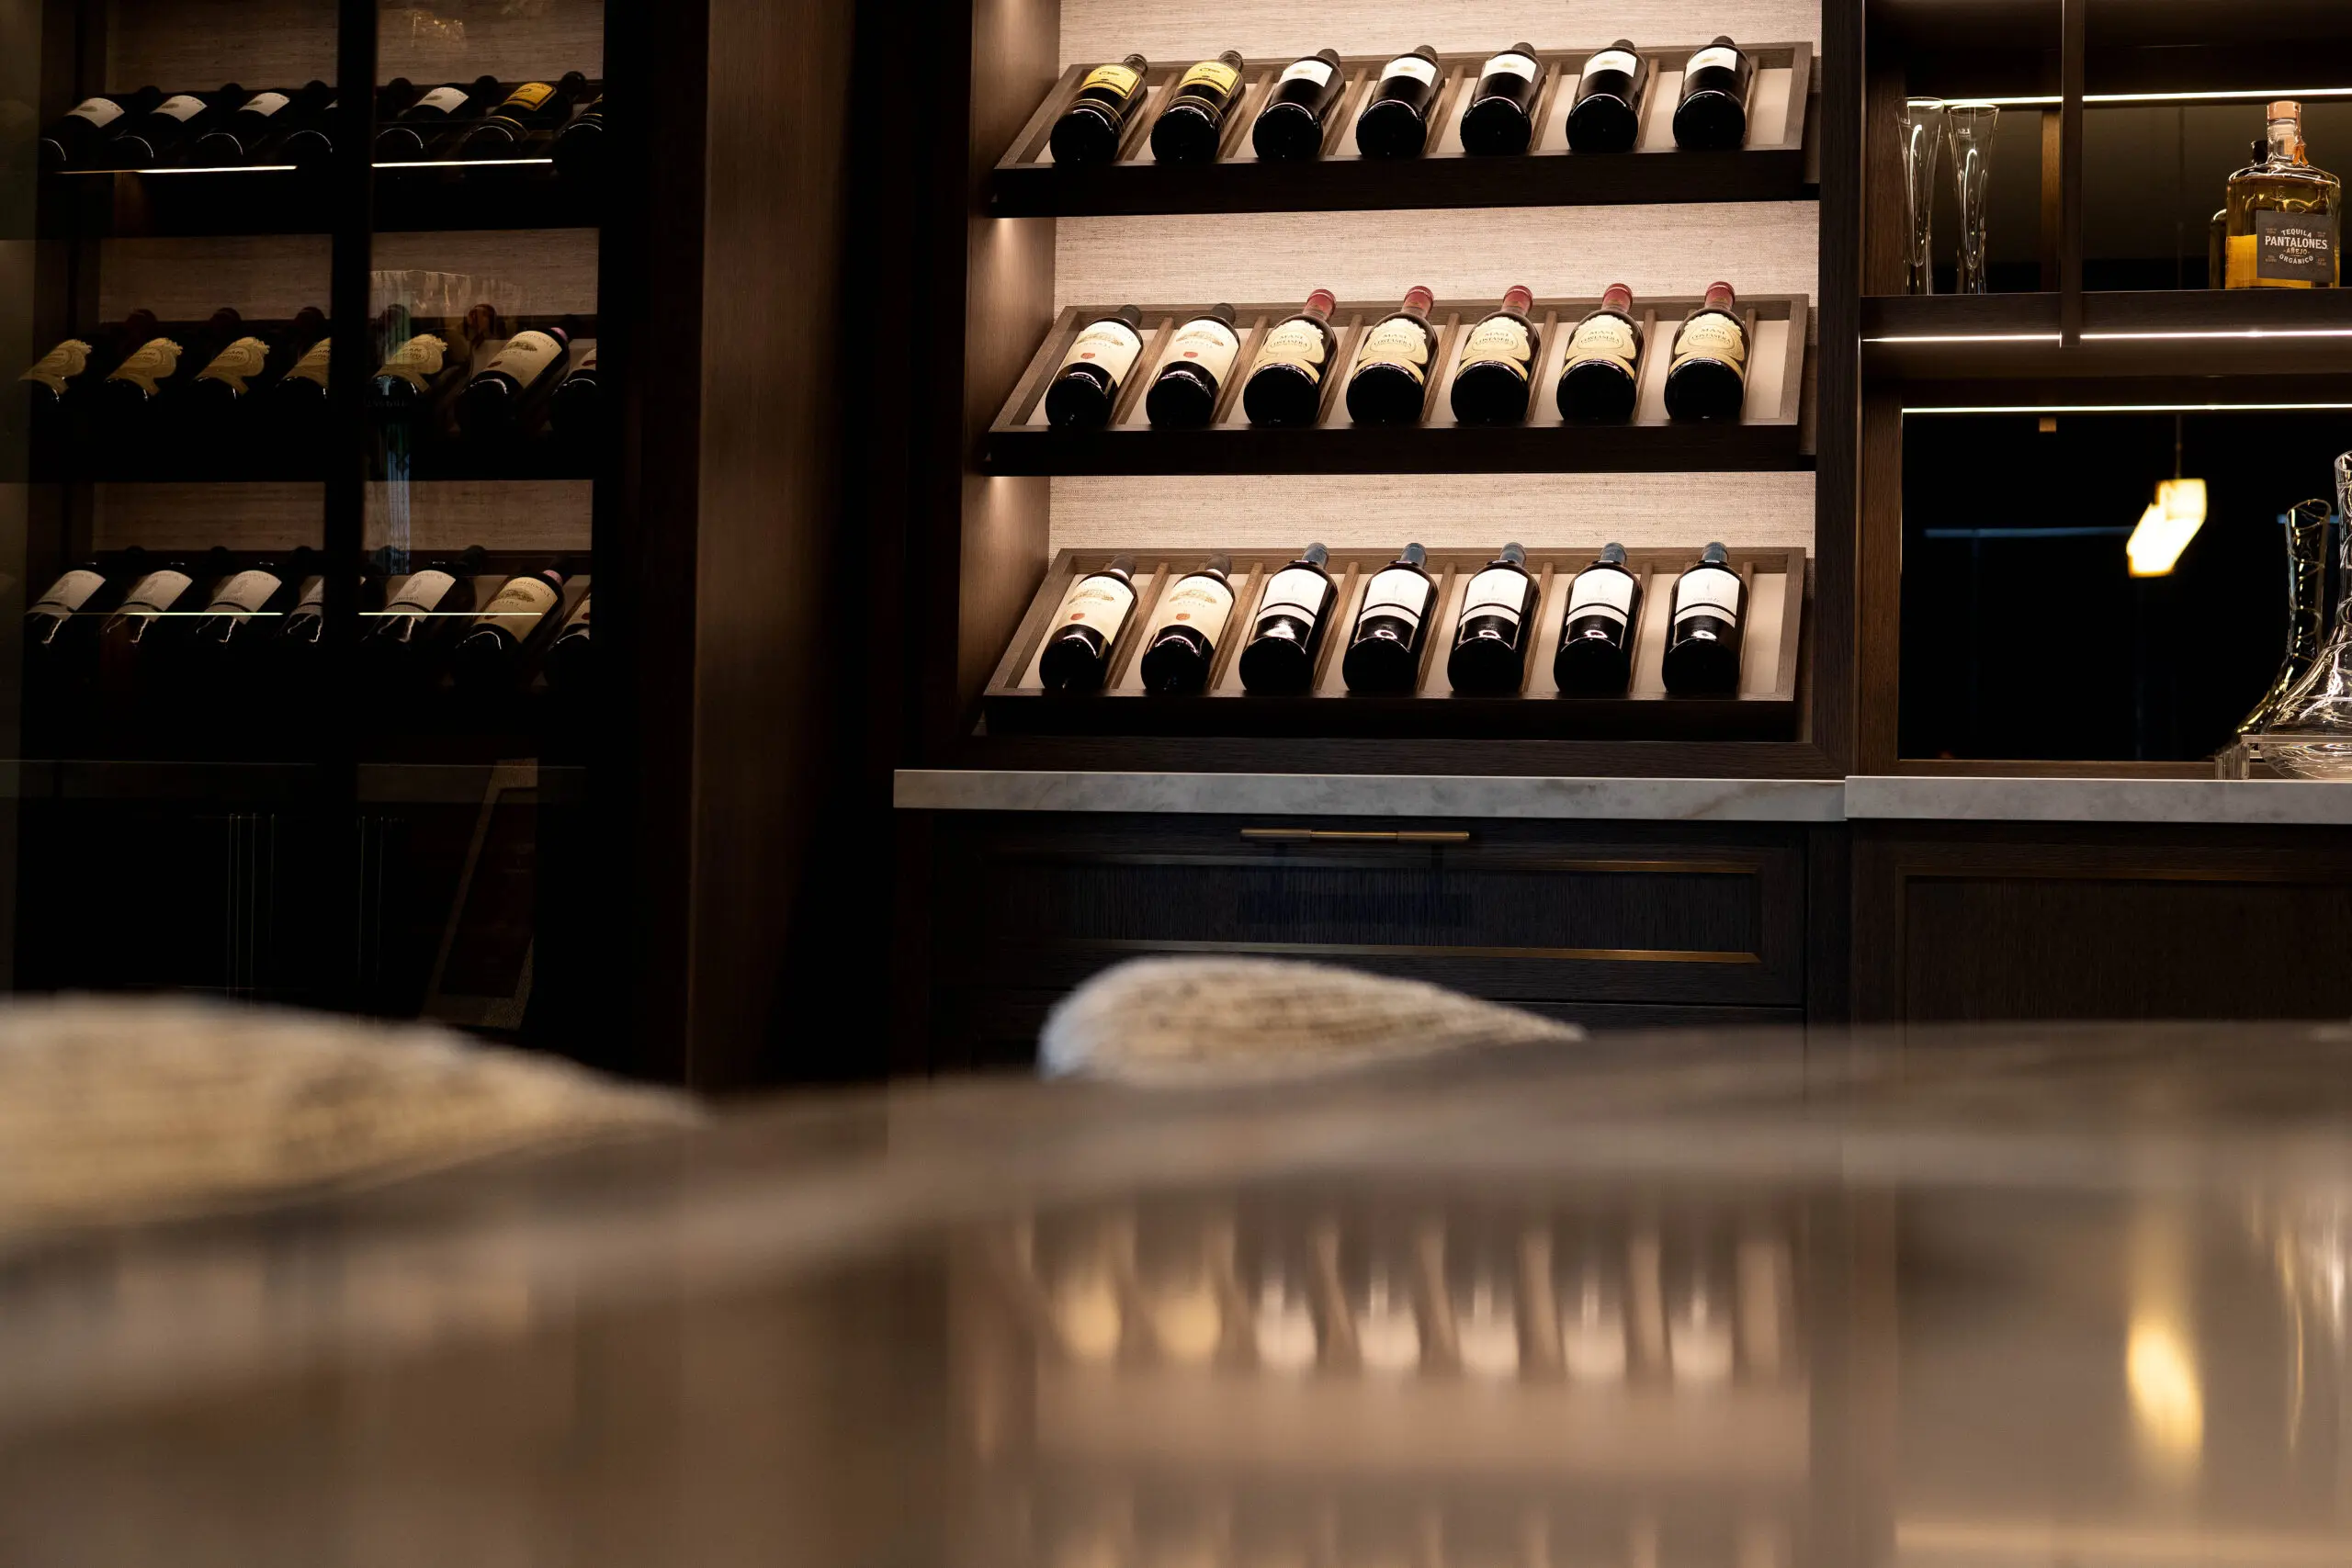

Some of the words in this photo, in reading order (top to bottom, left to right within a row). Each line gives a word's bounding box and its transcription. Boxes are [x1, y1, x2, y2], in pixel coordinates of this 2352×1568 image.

[2281, 228, 2312, 238] TEQUILA
[2265, 235, 2328, 250] PANTALONES
[2285, 247, 2308, 255] AÑEJO
[2278, 254, 2313, 265] ORGÁNICO
